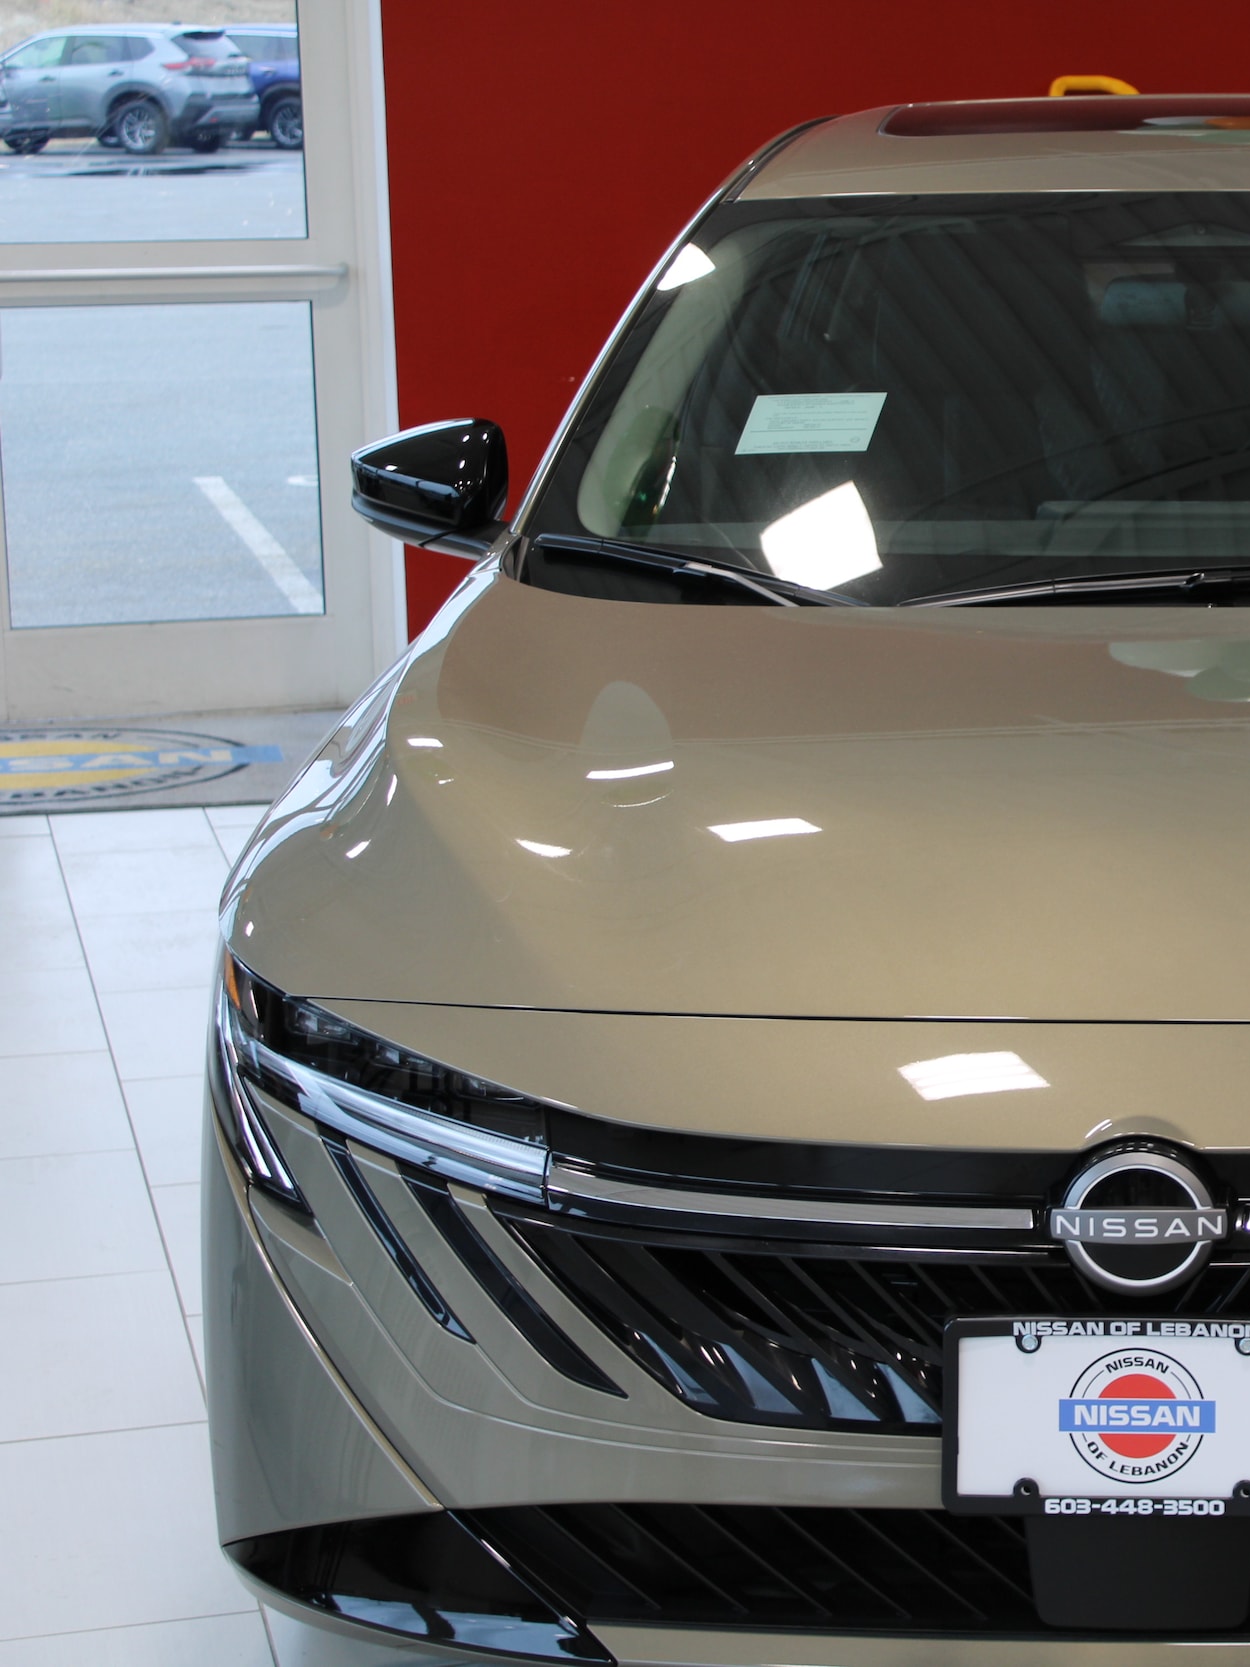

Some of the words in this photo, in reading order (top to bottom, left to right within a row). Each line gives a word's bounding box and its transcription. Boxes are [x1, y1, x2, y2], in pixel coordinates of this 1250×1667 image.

[1056, 1215, 1222, 1238] NISSAN
[1013, 1321, 1104, 1336] NISSAN
[1110, 1321, 1140, 1336] OF
[1105, 1356, 1169, 1374] NISSAN
[1074, 1404, 1200, 1427] NISSAN
[1087, 1441, 1107, 1460] OF
[1109, 1441, 1189, 1476] LEBANON
[1044, 1498, 1225, 1516] 603-448-3500
